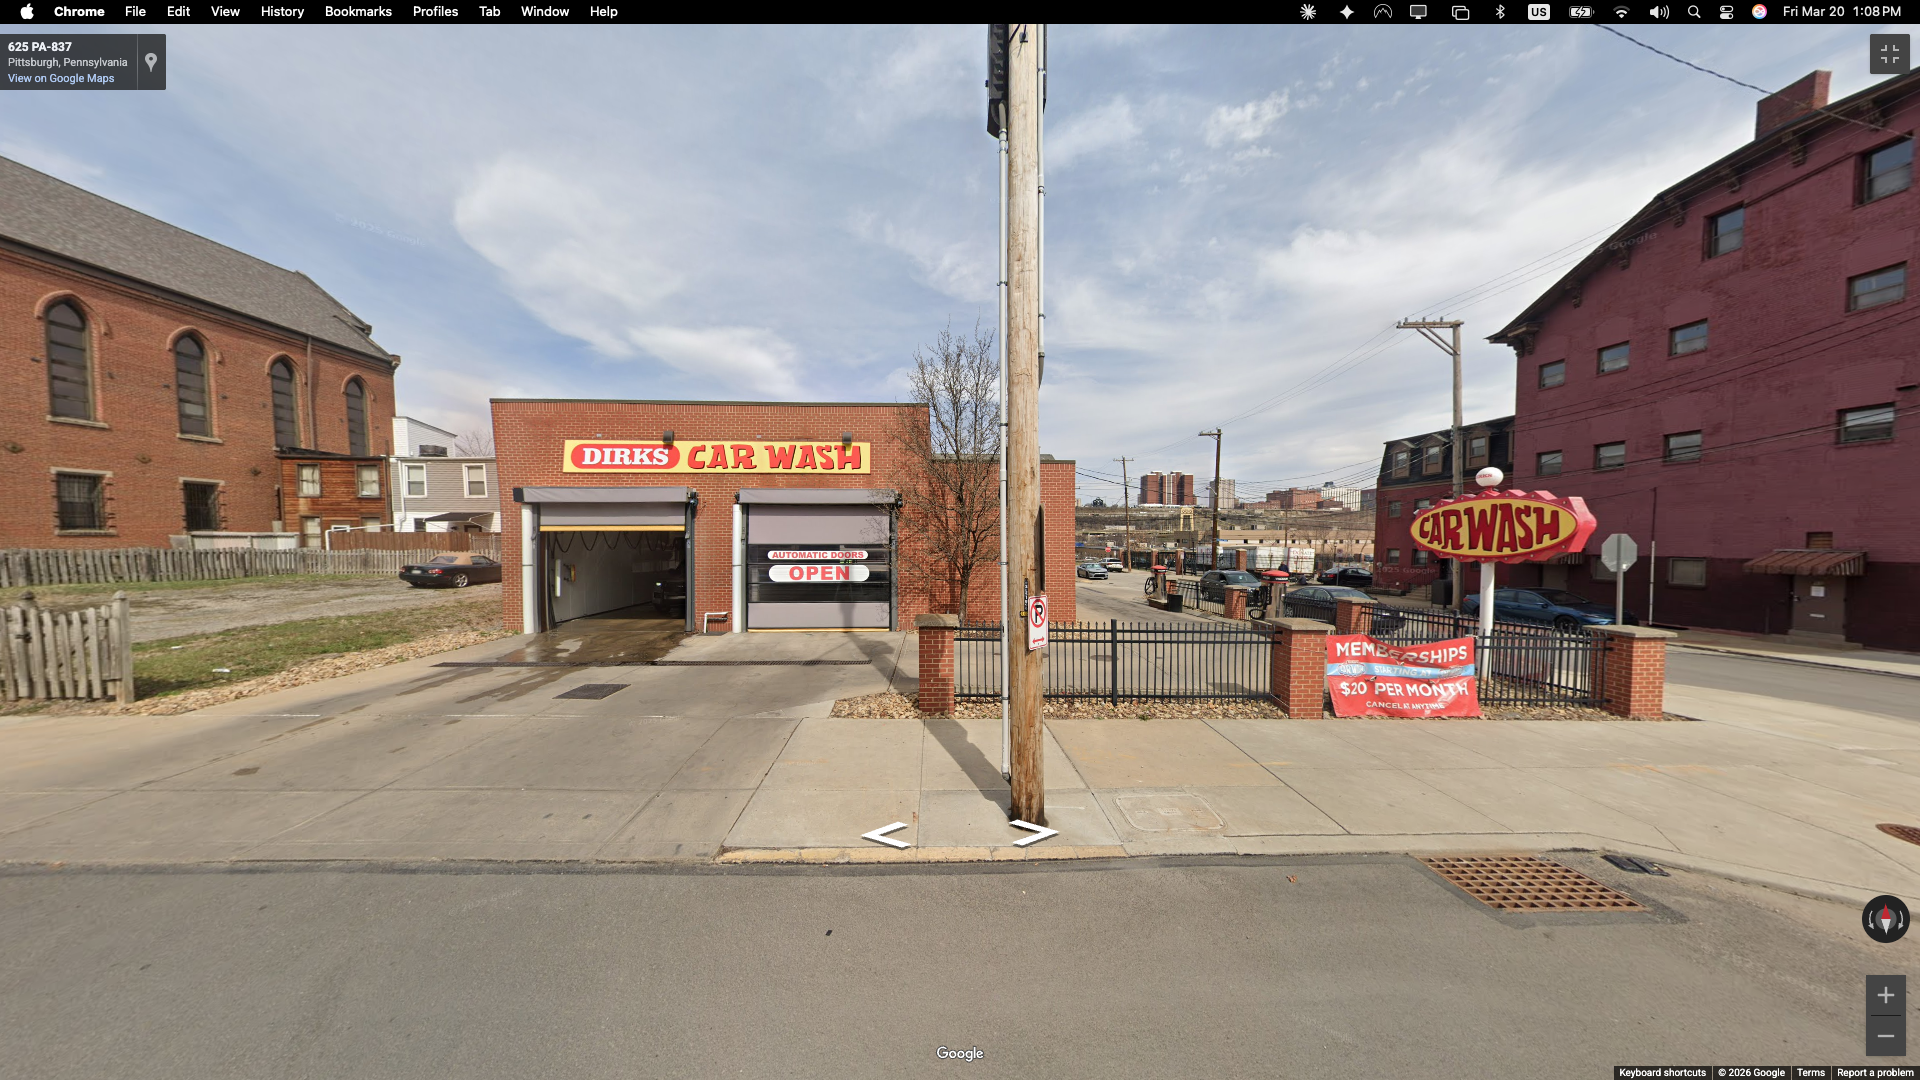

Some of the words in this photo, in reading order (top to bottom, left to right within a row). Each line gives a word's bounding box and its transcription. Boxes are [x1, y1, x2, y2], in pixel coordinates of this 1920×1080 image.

[582, 447, 669, 466] DIRKS
[687, 444, 757, 469] CAR
[764, 445, 862, 470] WASH
[1419, 509, 1465, 550] CAR
[1463, 502, 1560, 553] WASH
[771, 551, 828, 559] AUTOMATIC
[830, 551, 865, 559] DOORS
[788, 565, 851, 581] OPEN
[1335, 641, 1468, 664] MEMBERSHIPS
[1374, 665, 1417, 677] STARTING
[1420, 668, 1432, 677] AT
[1340, 681, 1368, 697] $20
[1374, 682, 1405, 697] PER
[1406, 682, 1469, 697] MONTH
[1365, 701, 1403, 710] CANCEL
[1411, 702, 1445, 710] ANYTIME
